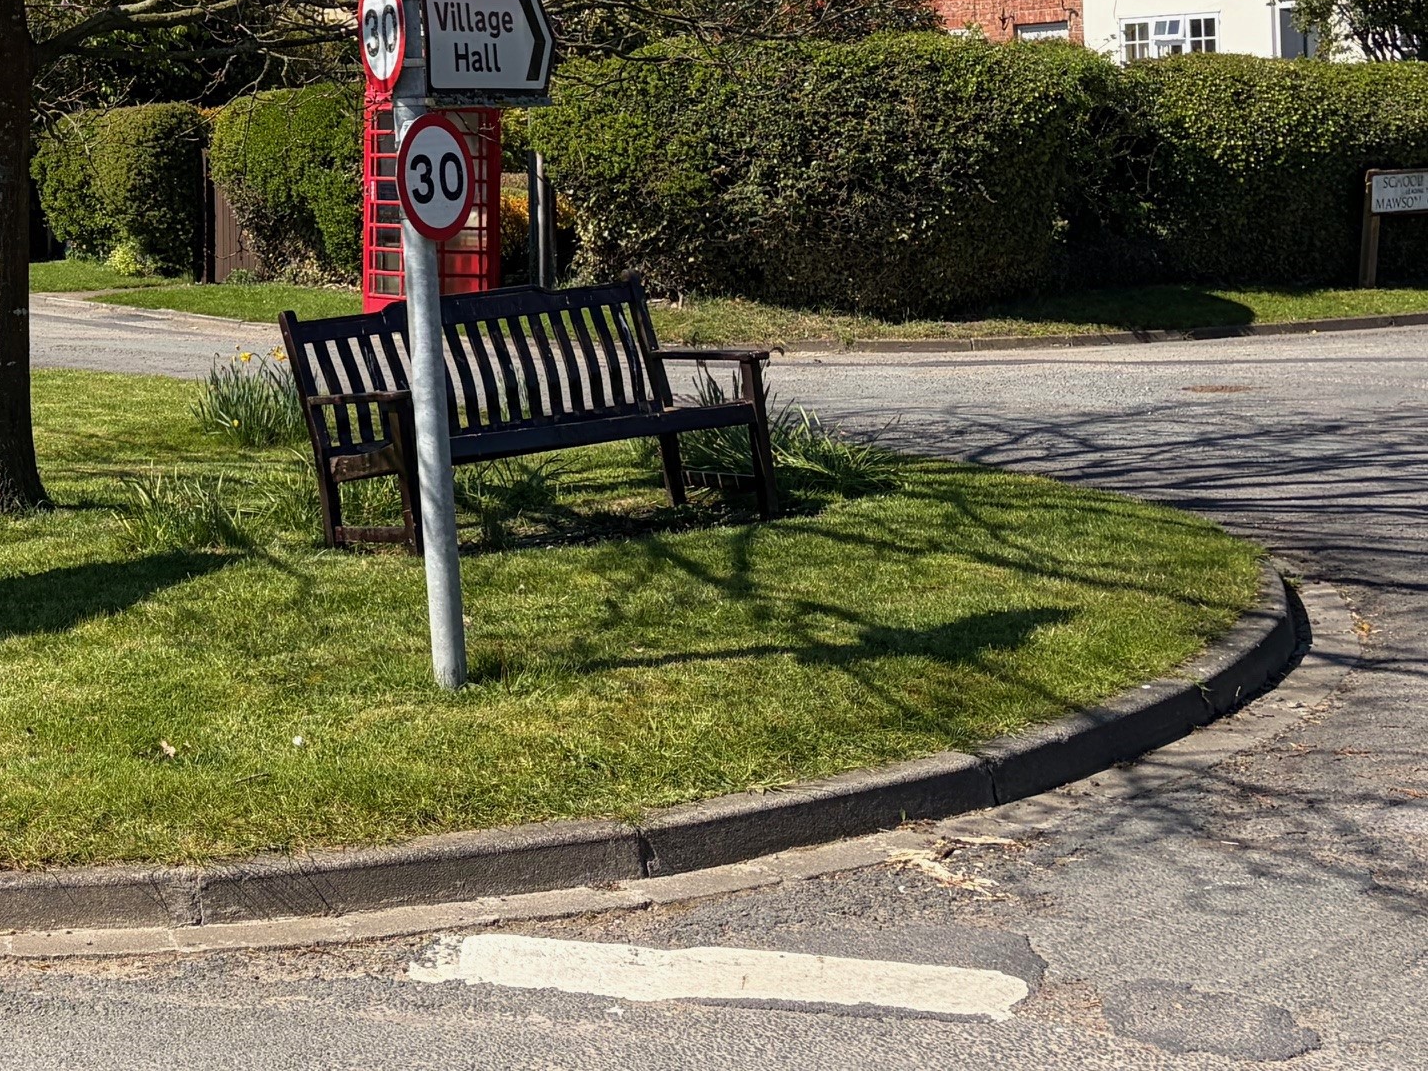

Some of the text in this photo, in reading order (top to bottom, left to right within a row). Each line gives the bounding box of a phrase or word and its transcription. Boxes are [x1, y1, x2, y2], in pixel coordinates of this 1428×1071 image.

[364, 4, 398, 58] 30
[433, 1, 514, 39] Village
[453, 42, 502, 74] Hall
[410, 151, 464, 205] 30
